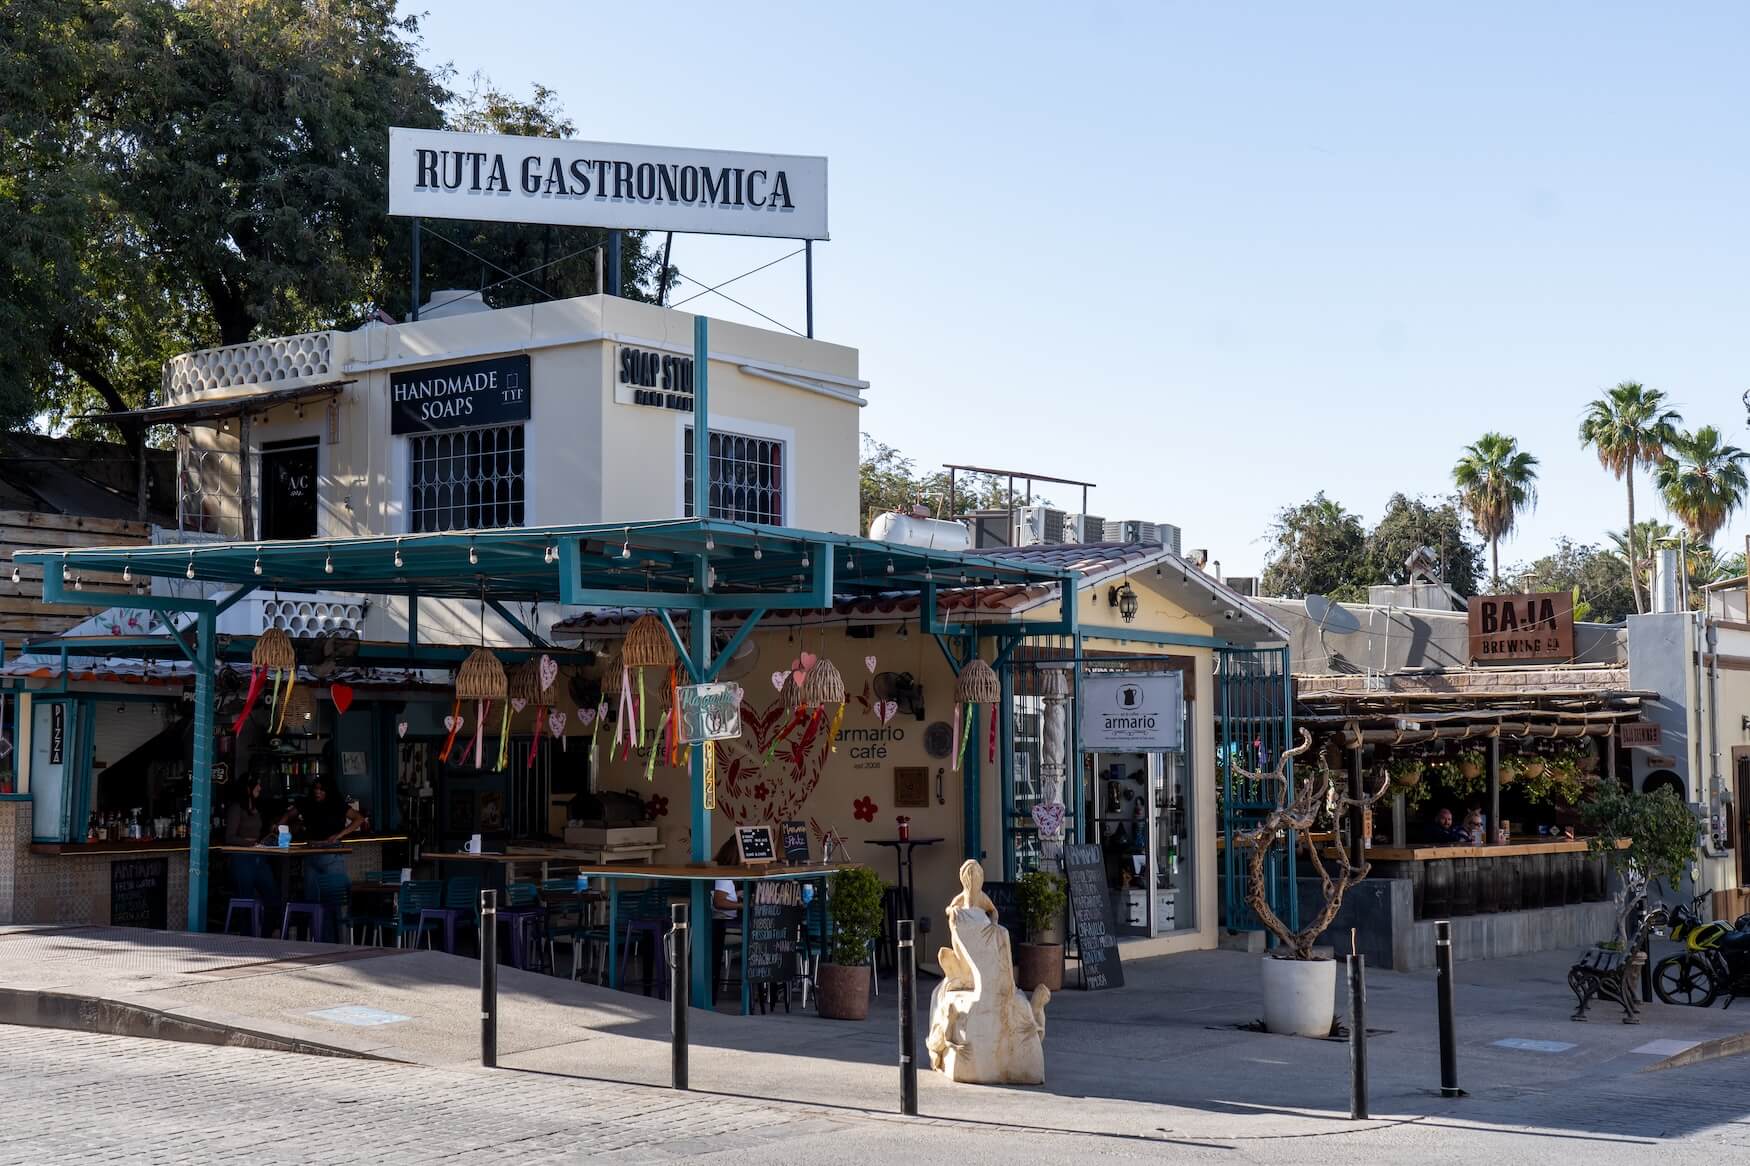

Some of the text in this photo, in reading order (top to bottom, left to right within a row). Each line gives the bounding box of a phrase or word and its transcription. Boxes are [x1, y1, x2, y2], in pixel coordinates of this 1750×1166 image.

[415, 149, 795, 209] RUTA GASTRONOMICA
[620, 347, 660, 387] SOAP
[394, 371, 498, 401] HANDMADE
[421, 397, 473, 420] SOAPS
[1481, 598, 1557, 633] BAJA
[1483, 639, 1541, 654] BREWING
[53, 704, 62, 763] PIZZA
[834, 726, 905, 741] armario
[1105, 715, 1155, 729] armario
[849, 743, 887, 759] café
